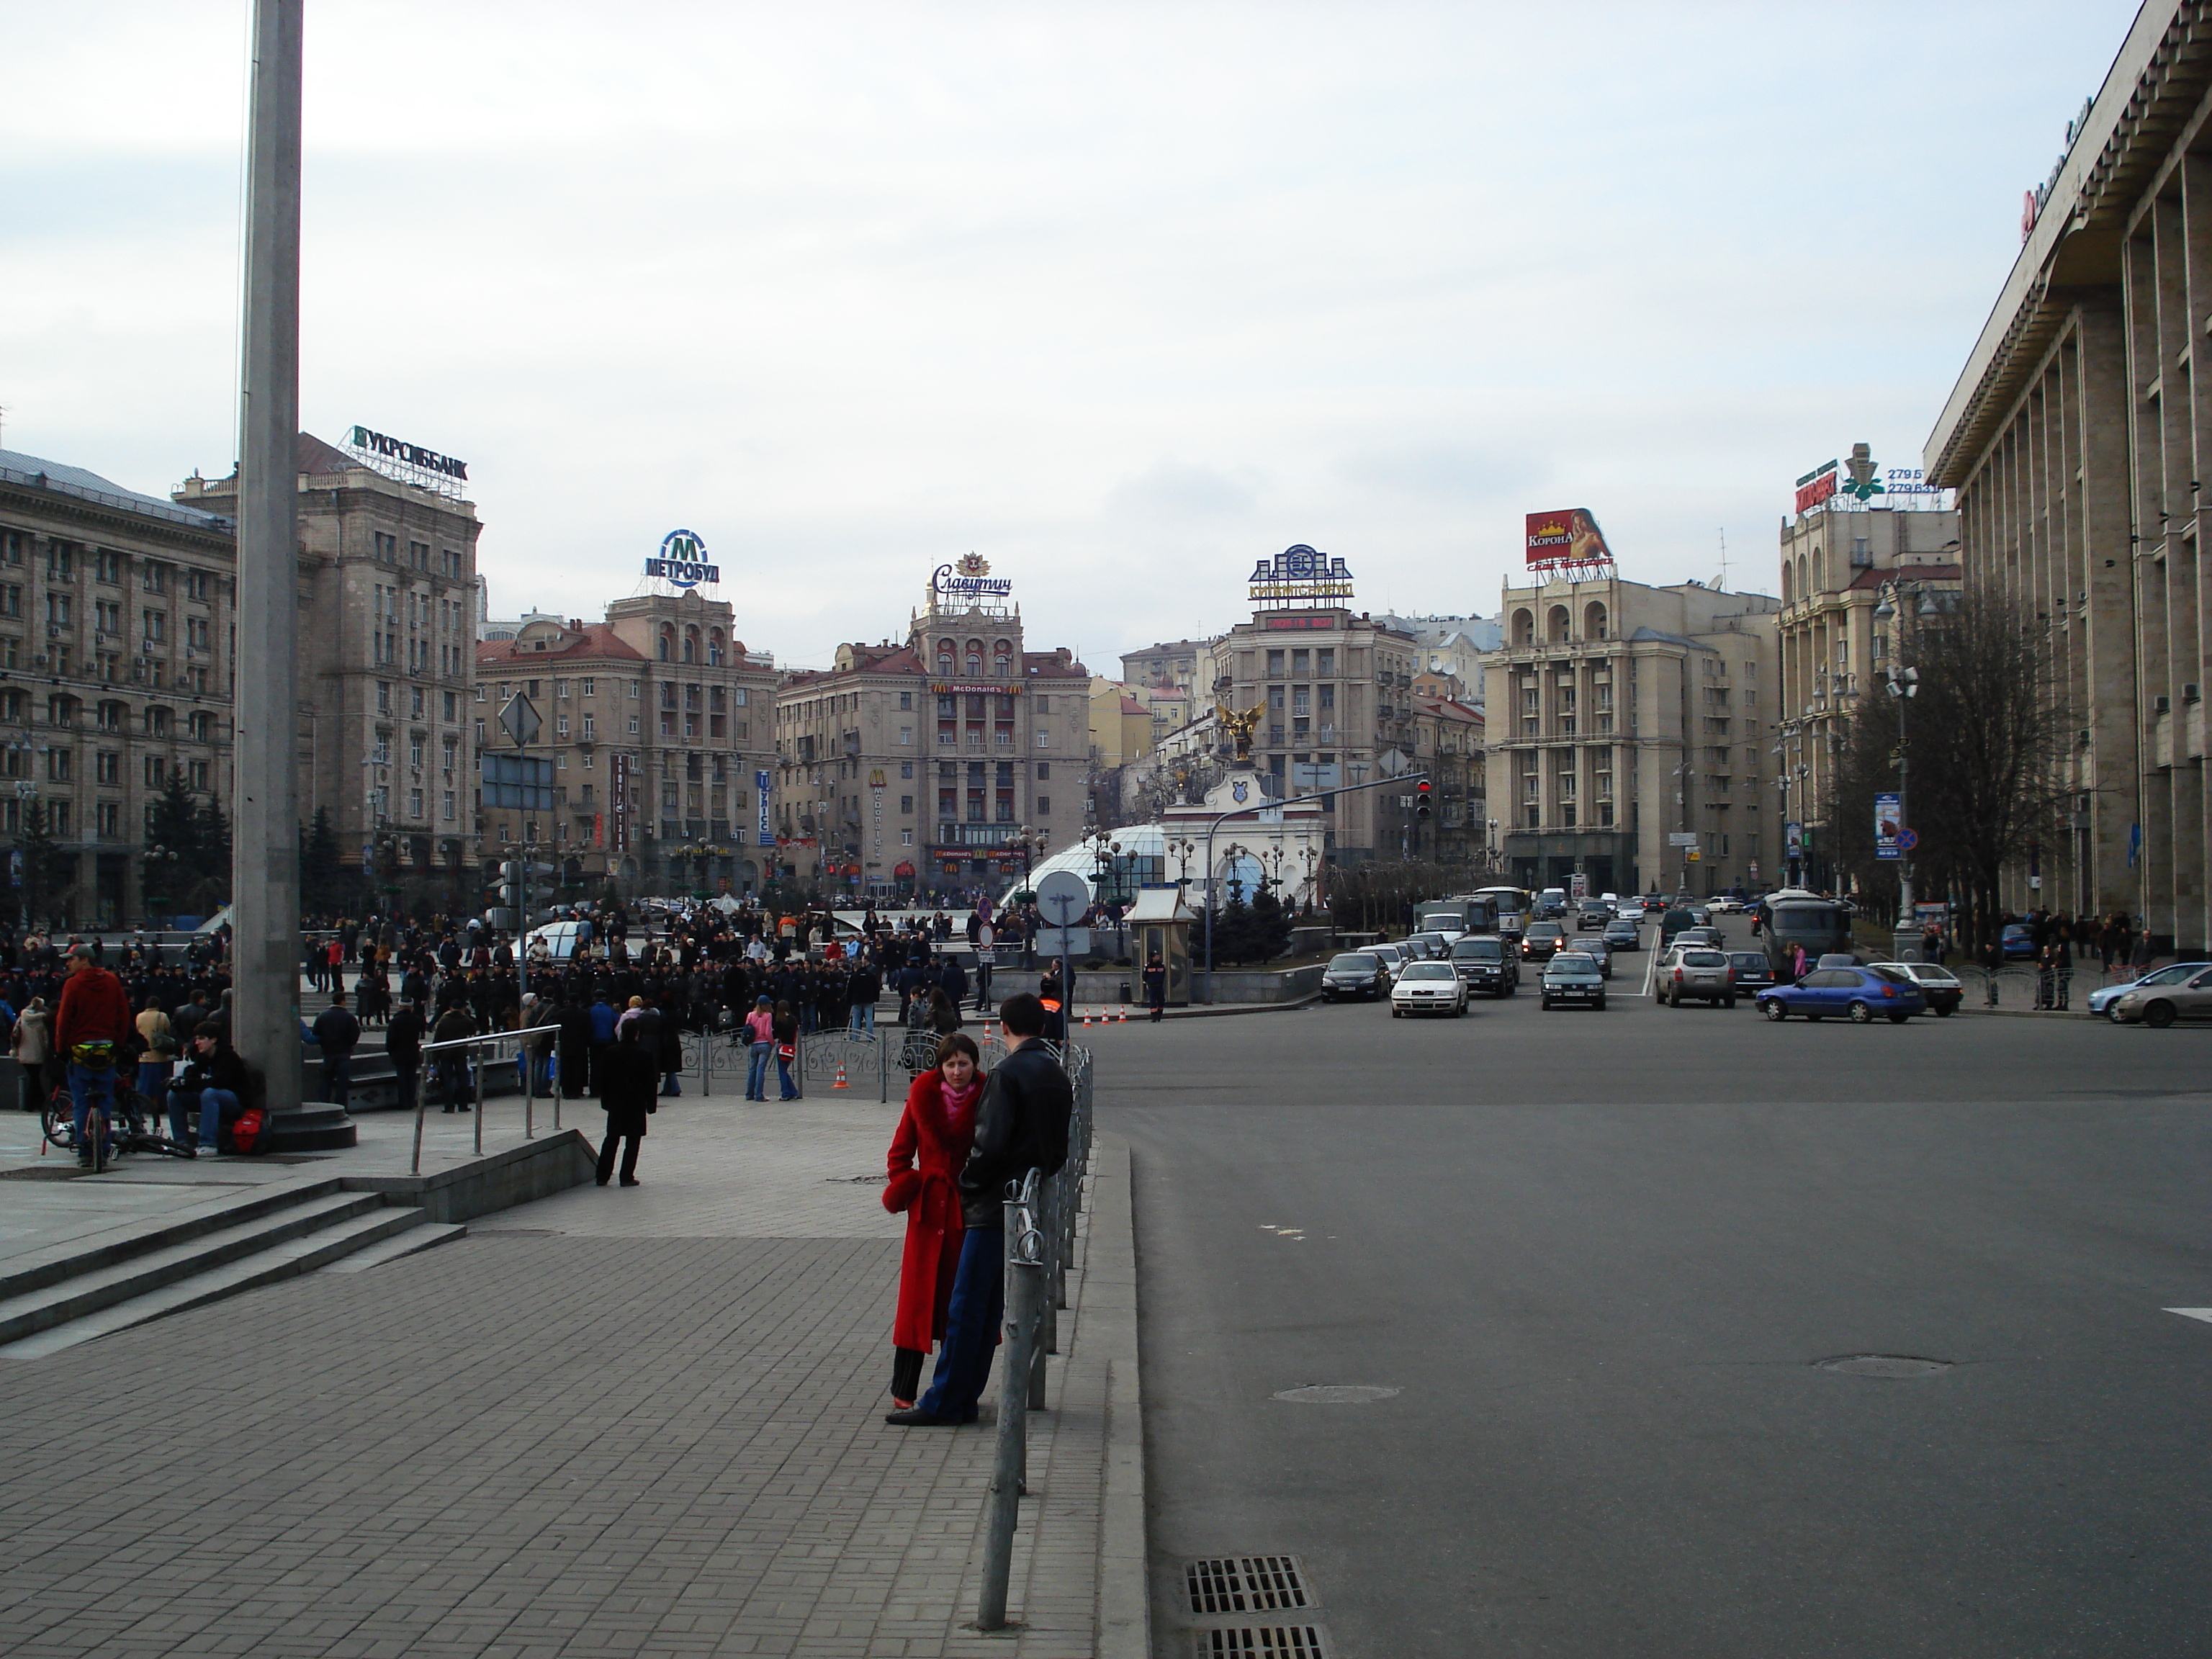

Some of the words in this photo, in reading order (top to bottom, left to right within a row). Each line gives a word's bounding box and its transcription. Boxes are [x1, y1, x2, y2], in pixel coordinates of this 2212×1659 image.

[367, 430, 469, 481] УКРСИББАНК
[645, 557, 719, 583] МЕТРОБУД
[932, 564, 1012, 599] Славутич
[1250, 583, 1354, 598] КИЇВМІСЬКБУД
[873, 787, 883, 858] McDonald's
